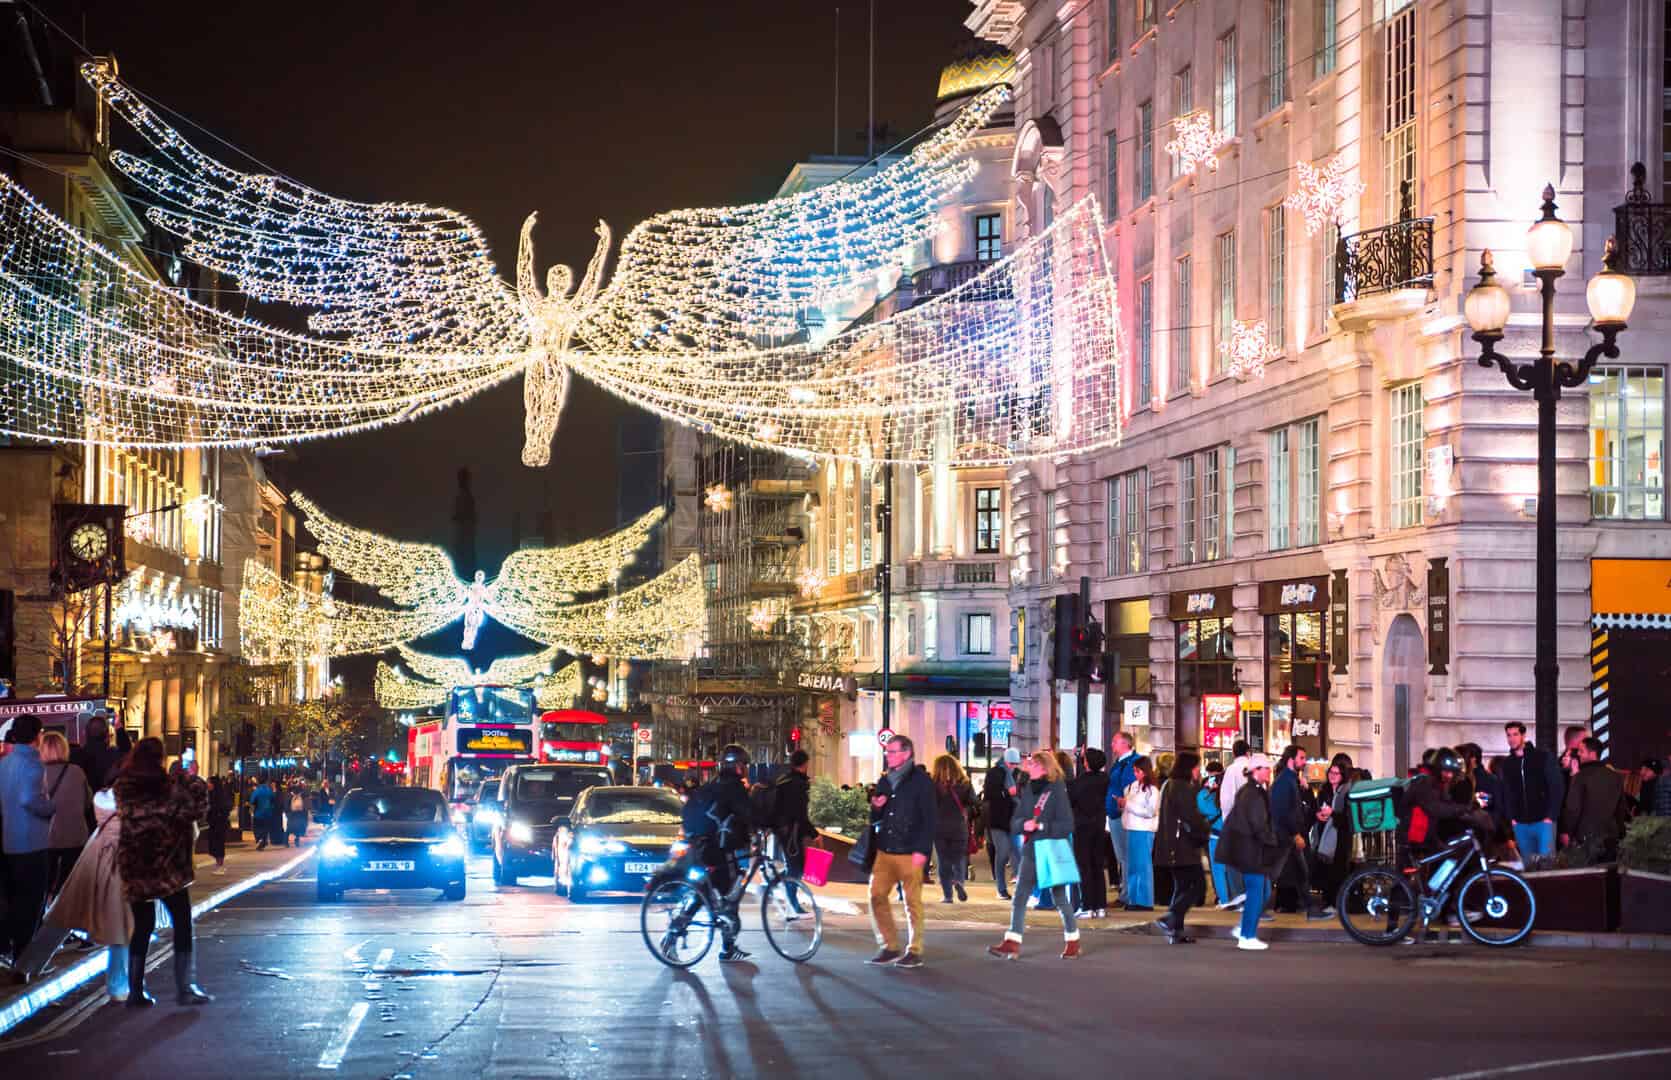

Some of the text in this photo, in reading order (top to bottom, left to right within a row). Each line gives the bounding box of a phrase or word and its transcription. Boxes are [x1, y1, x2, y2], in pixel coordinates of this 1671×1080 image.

[798, 672, 845, 692] CINEMA
[36, 704, 49, 713] ICE
[54, 702, 87, 713] CREAM
